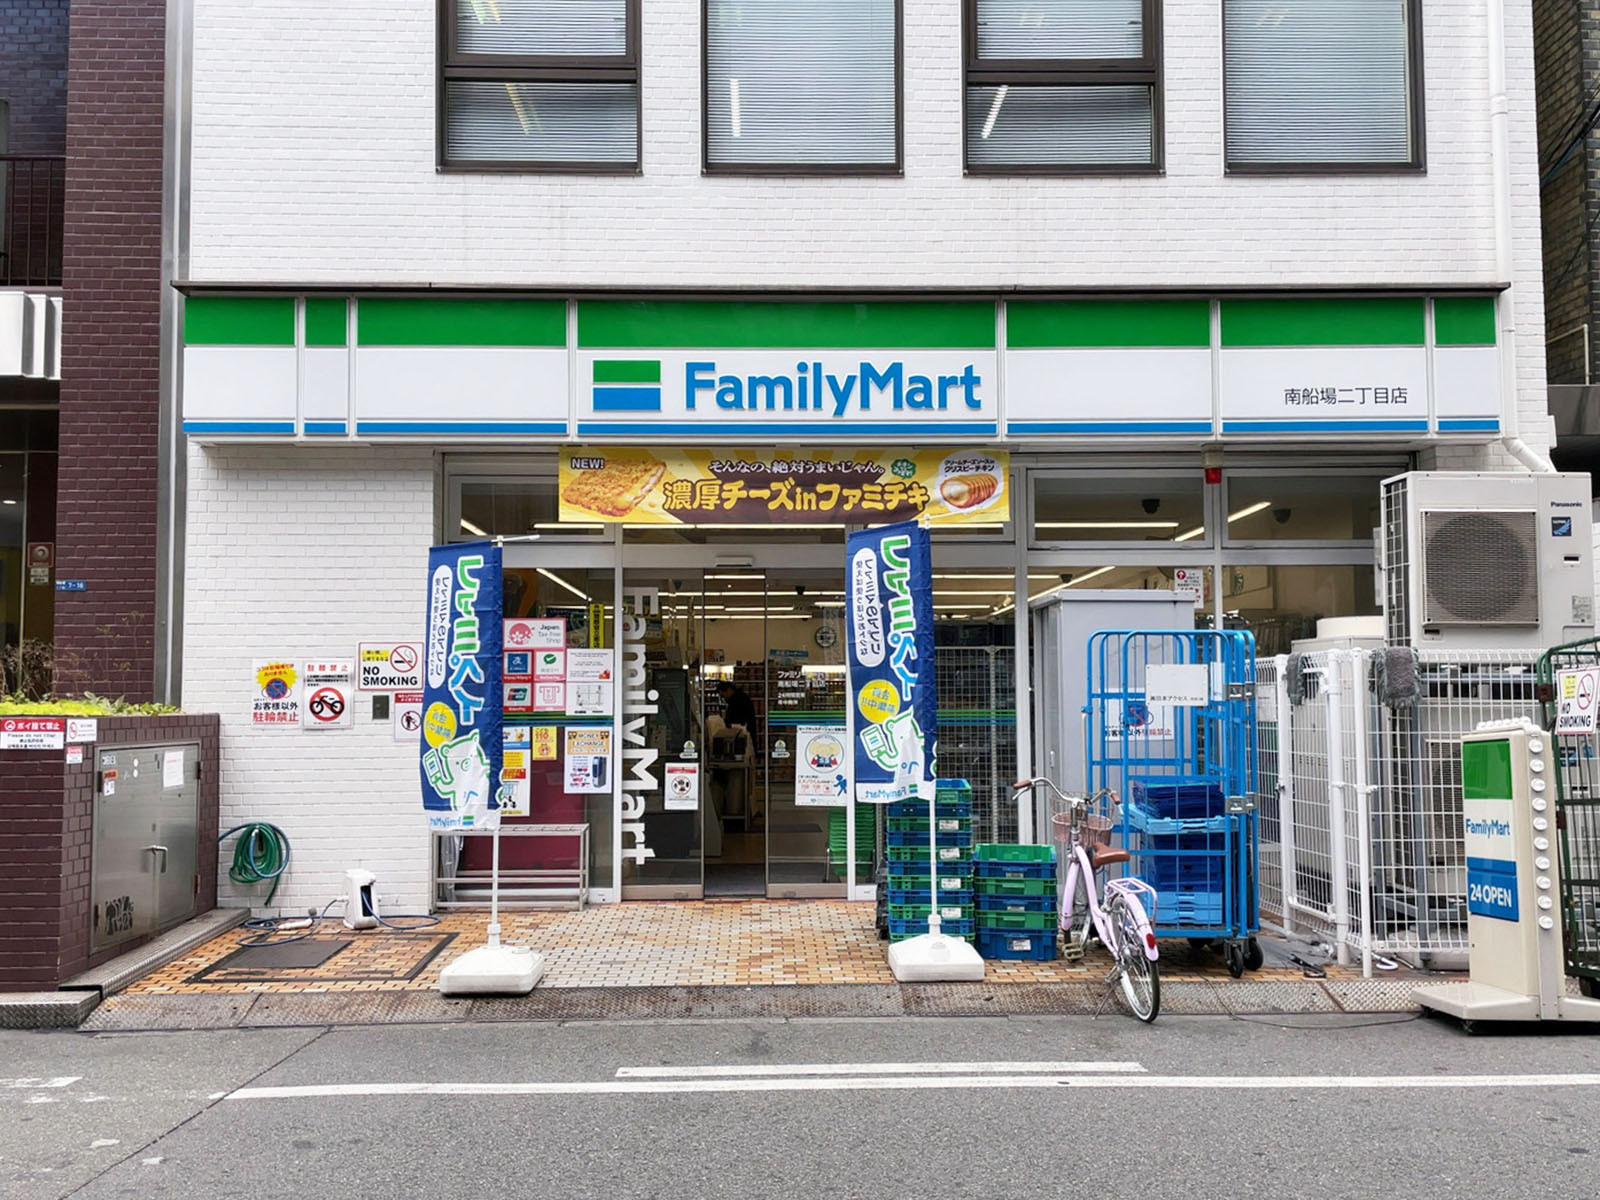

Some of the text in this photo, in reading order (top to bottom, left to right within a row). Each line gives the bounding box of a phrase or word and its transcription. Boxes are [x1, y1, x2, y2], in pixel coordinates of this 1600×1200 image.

[685, 362, 982, 417] FamilyMart
[1284, 387, 1408, 405] 南船場二丁目店
[571, 458, 605, 470] NEW!
[709, 459, 886, 475] そんなの、絶対うまいじゃん。
[944, 465, 995, 473] クリスピーチキン
[663, 477, 930, 512] 濃厚チーズinファミチキ
[363, 666, 380, 675] NO
[362, 676, 418, 686] SMOKING
[253, 702, 298, 711] お客様以外
[1561, 703, 1570, 714] NO
[253, 711, 299, 722] 駐輪禁止
[1559, 715, 1591, 728] SMOKING
[17, 722, 61, 730] ポイ捨て禁止
[622, 587, 659, 865] FamilyMart
[1465, 818, 1511, 839] FamilyMart
